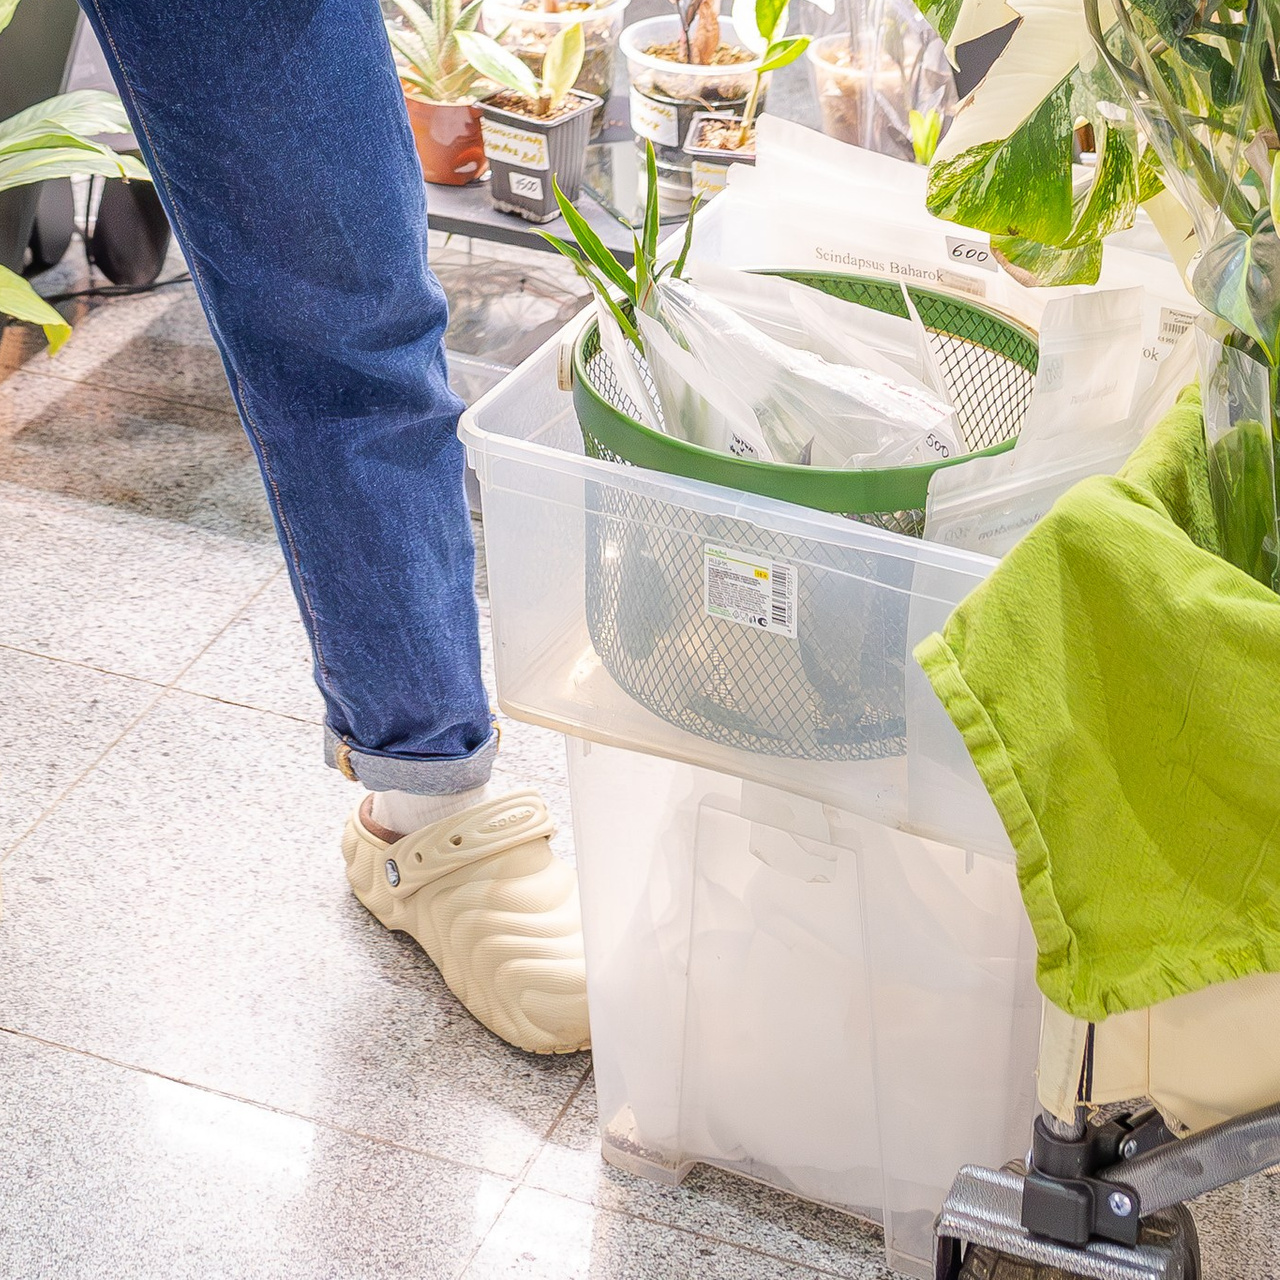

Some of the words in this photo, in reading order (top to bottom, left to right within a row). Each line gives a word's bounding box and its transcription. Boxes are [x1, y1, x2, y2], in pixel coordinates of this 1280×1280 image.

[815, 246, 885, 271] Scindapsus
[889, 261, 944, 282] Baharok
[951, 243, 989, 263] 600
[925, 433, 950, 459] 500
